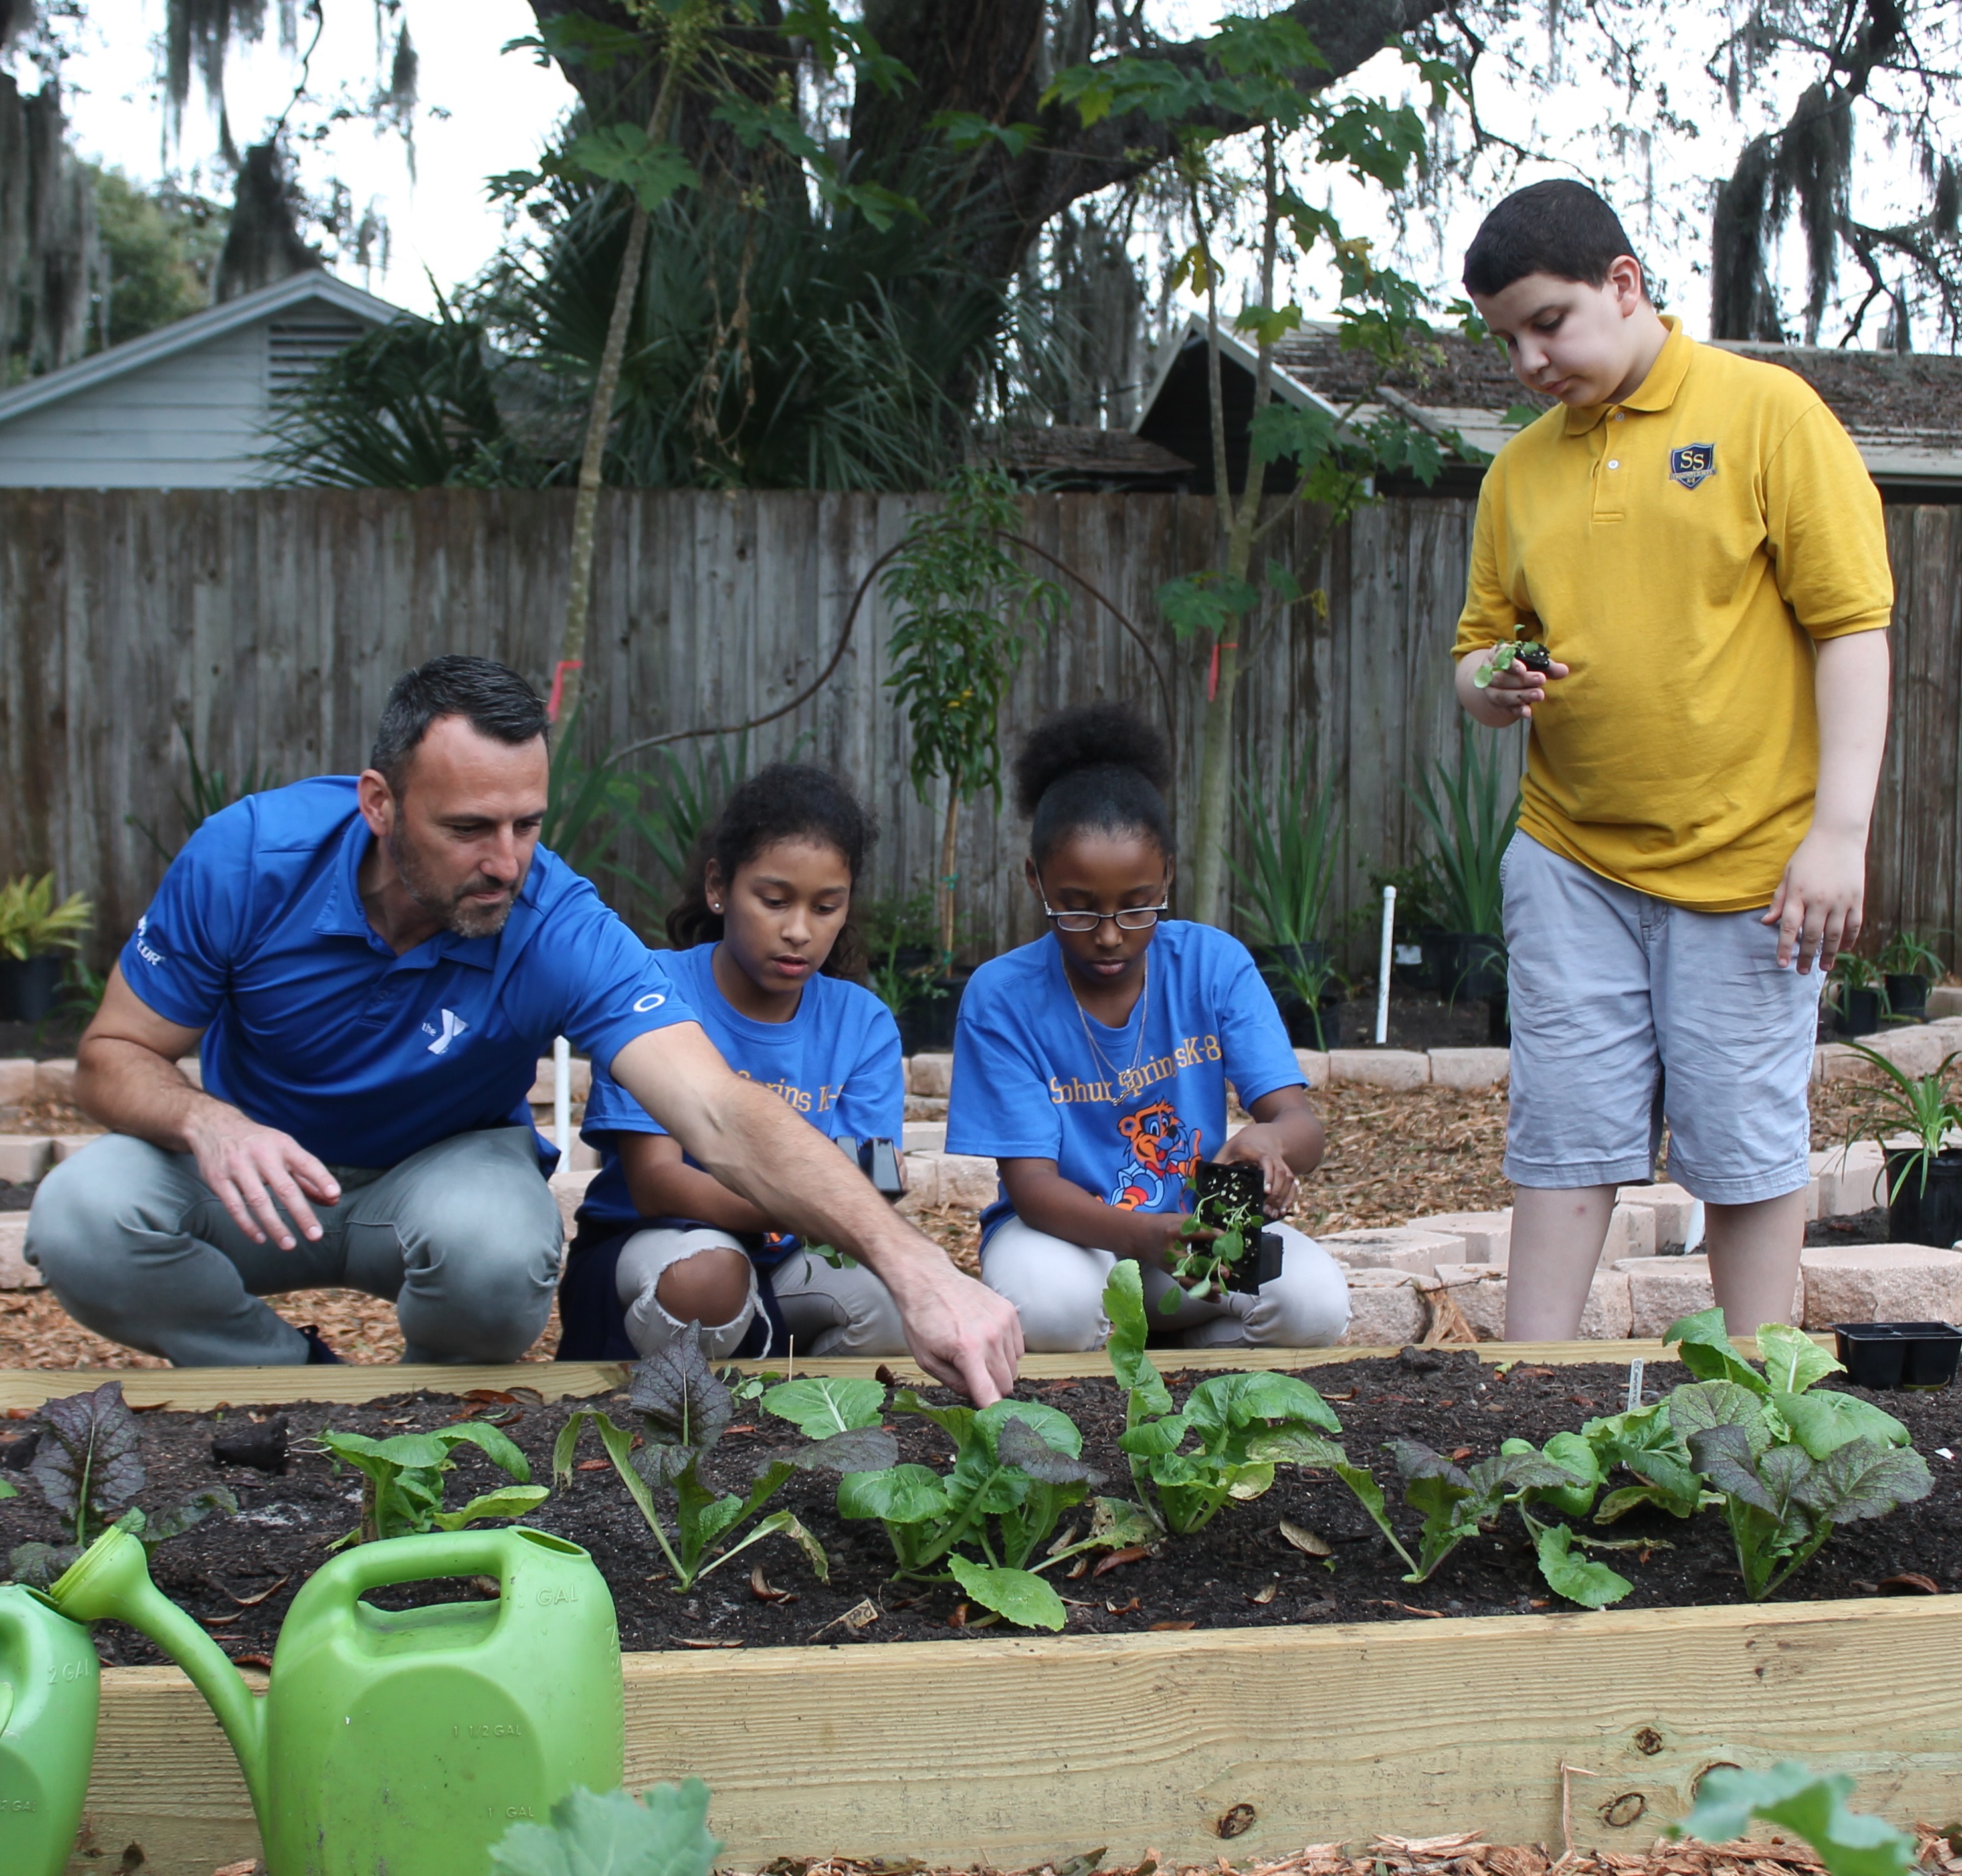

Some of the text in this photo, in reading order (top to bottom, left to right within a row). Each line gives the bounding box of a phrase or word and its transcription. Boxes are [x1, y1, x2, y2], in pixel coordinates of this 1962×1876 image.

[1680, 450, 1705, 470] SS
[421, 1022, 437, 1037] the
[536, 1584, 579, 1607] GAL
[48, 1658, 90, 1685] 2 GAL
[494, 1724, 522, 1737] GAL
[12, 1800, 37, 1812] GAL
[488, 1806, 534, 1819] 1 GAL
